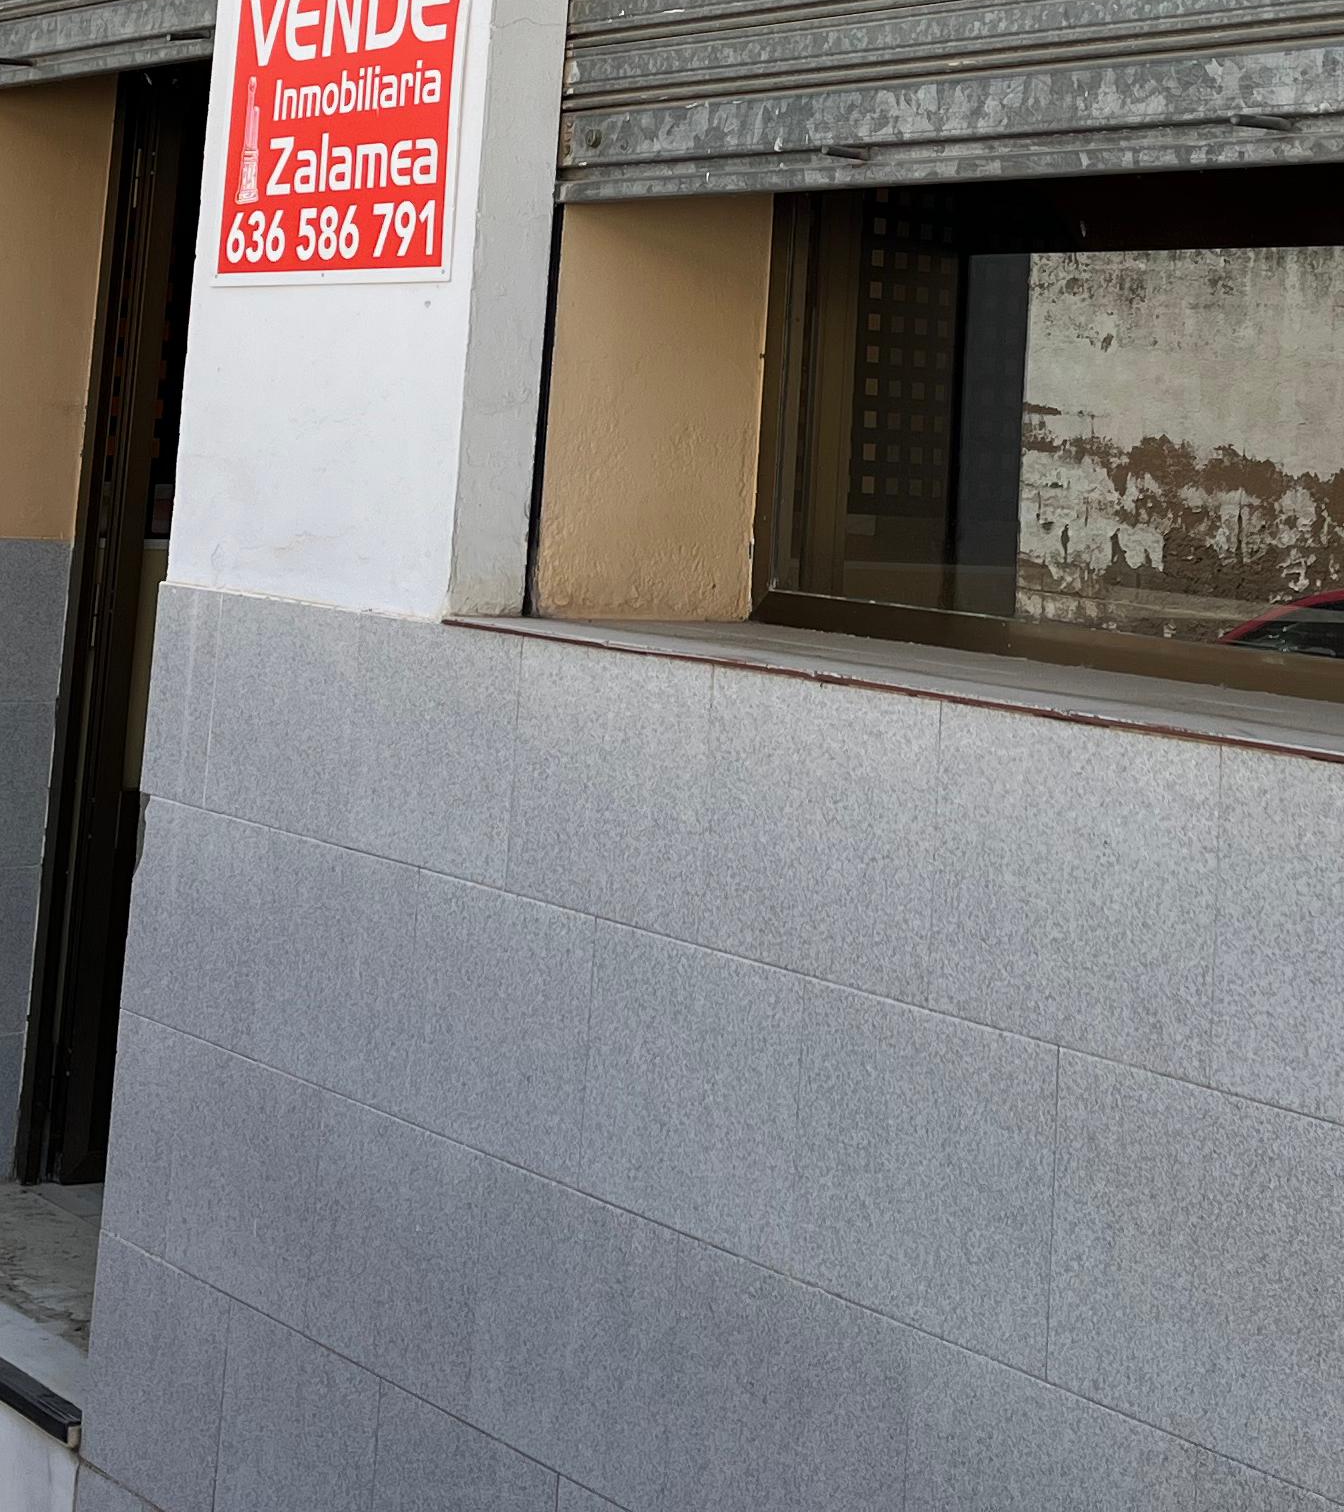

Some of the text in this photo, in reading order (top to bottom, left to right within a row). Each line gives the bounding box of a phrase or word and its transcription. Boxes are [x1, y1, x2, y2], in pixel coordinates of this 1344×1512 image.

[272, 59, 442, 122] Inmobiliaria
[265, 132, 439, 196] Zalamea
[226, 199, 436, 263] 636 586 791
